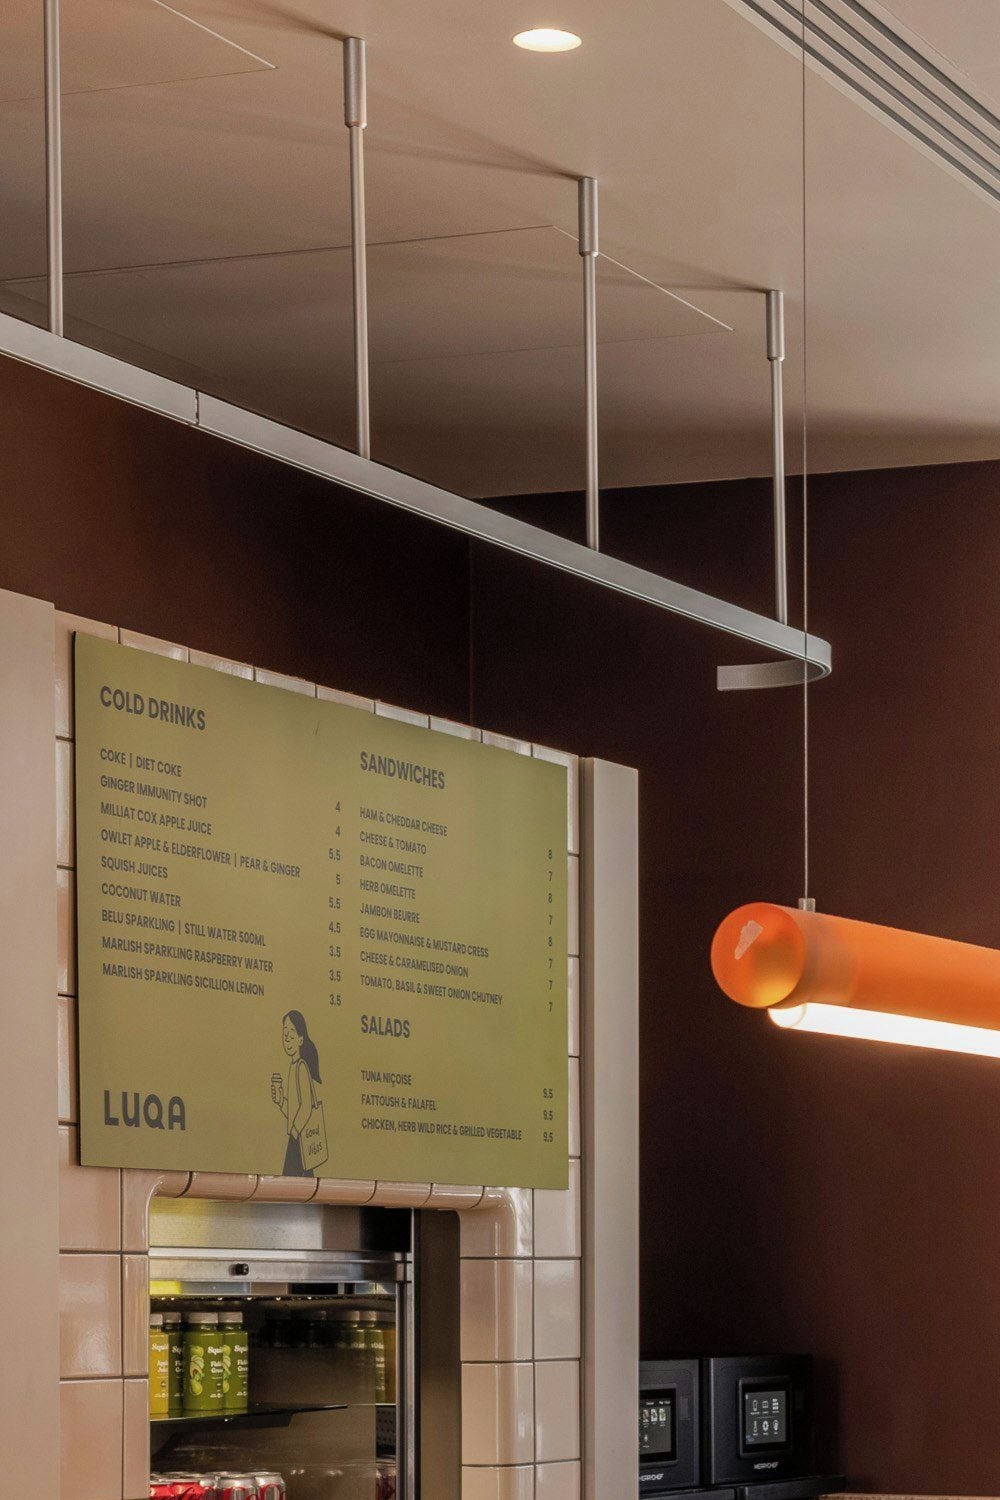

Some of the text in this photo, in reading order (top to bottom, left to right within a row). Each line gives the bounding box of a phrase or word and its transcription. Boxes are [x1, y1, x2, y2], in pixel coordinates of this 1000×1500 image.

[100, 685, 206, 730] COLD DRINKS
[100, 748, 126, 766] COKE
[136, 756, 156, 772] DIET
[156, 760, 182, 777] COKE
[360, 751, 445, 790] SANDWICHES
[100, 775, 207, 809] GINGER IMMUNITY SHOT
[335, 801, 341, 812] 4
[100, 802, 212, 835] MILLIAT COX APPLE JUICE
[360, 807, 448, 837] HAM & CHEDDAR CHEESE
[335, 826, 341, 837] 4
[100, 828, 133, 847] OWLET
[134, 835, 161, 852] APPLE
[162, 840, 170, 854] &
[171, 842, 231, 865] ELDERFLOWER
[239, 856, 261, 871] PEAR
[262, 859, 269, 872] &
[270, 860, 300, 878] GINGER
[359, 830, 427, 856] CHEESE & TOMATO
[328, 848, 341, 861] 5.5
[101, 856, 168, 879] SQUISH JUICES
[360, 854, 423, 878] BACON OMELETTE
[548, 871, 552, 882] 7
[335, 874, 341, 885] 5
[360, 878, 416, 900] HERB OMELETTE
[101, 882, 181, 907] COCONUT WATER
[328, 897, 341, 909] 5.5
[360, 903, 420, 924] JAMBON BEURRE
[549, 915, 553, 925] 7
[102, 909, 124, 925] BELU
[125, 913, 175, 933] SPARKLING
[184, 922, 206, 938] STILL
[207, 926, 237, 942] WATER
[238, 930, 265, 947] 500ML
[328, 922, 341, 934] 4.5
[329, 946, 341, 958] 3.5
[360, 926, 489, 959] EGG MAYONNAISE & MUSTARD CRESS
[102, 936, 273, 973] MARLISH SPARKLING RASPBERRY WATER
[360, 950, 469, 978] CHEESE & CARAMELISED ONION
[549, 959, 553, 969] 7
[102, 962, 265, 996] MARLISH SPARKLING SICILLION LEMON
[329, 970, 341, 982] 3.5
[549, 980, 553, 990] 7
[330, 994, 341, 1006] 3.5
[360, 974, 503, 1005] TOMATO, BASIL & SWEET ONION CHUTNEY
[549, 1002, 553, 1012] 7
[360, 1014, 410, 1039] SALADS
[361, 1069, 412, 1088] TUNA NIÇOISE
[361, 1094, 436, 1111] FATTOUSH & FALAFEL
[543, 1088, 553, 1099] 9.5
[104, 1090, 186, 1130] LUQA
[543, 1110, 553, 1121] 9.5
[361, 1118, 522, 1141] CHICKEN, HERB WILD RICE & GRILLED VEGETABLE
[543, 1132, 553, 1142] 9.5
